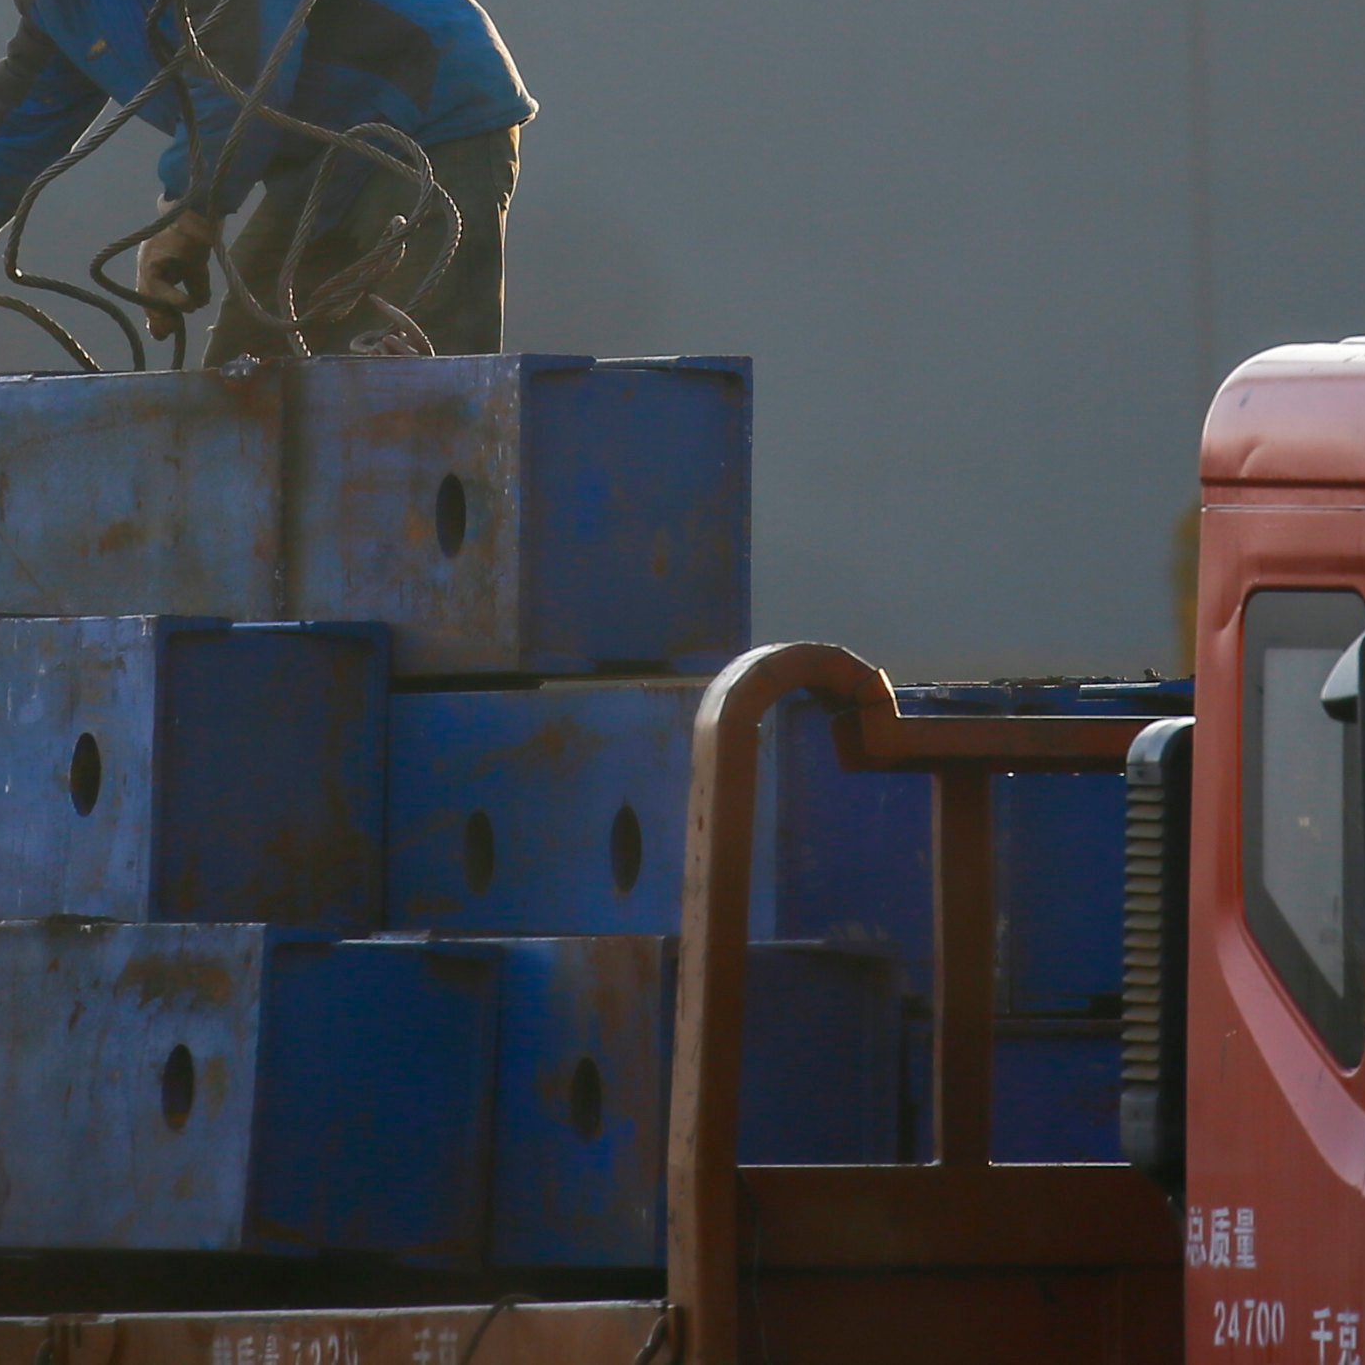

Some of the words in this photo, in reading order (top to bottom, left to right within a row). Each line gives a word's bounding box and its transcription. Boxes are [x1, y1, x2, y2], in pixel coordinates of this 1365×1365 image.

[1186, 1206, 1257, 1268] 总质量
[1213, 1299, 1285, 1348] 24700
[1310, 1307, 1361, 1365] 千克
